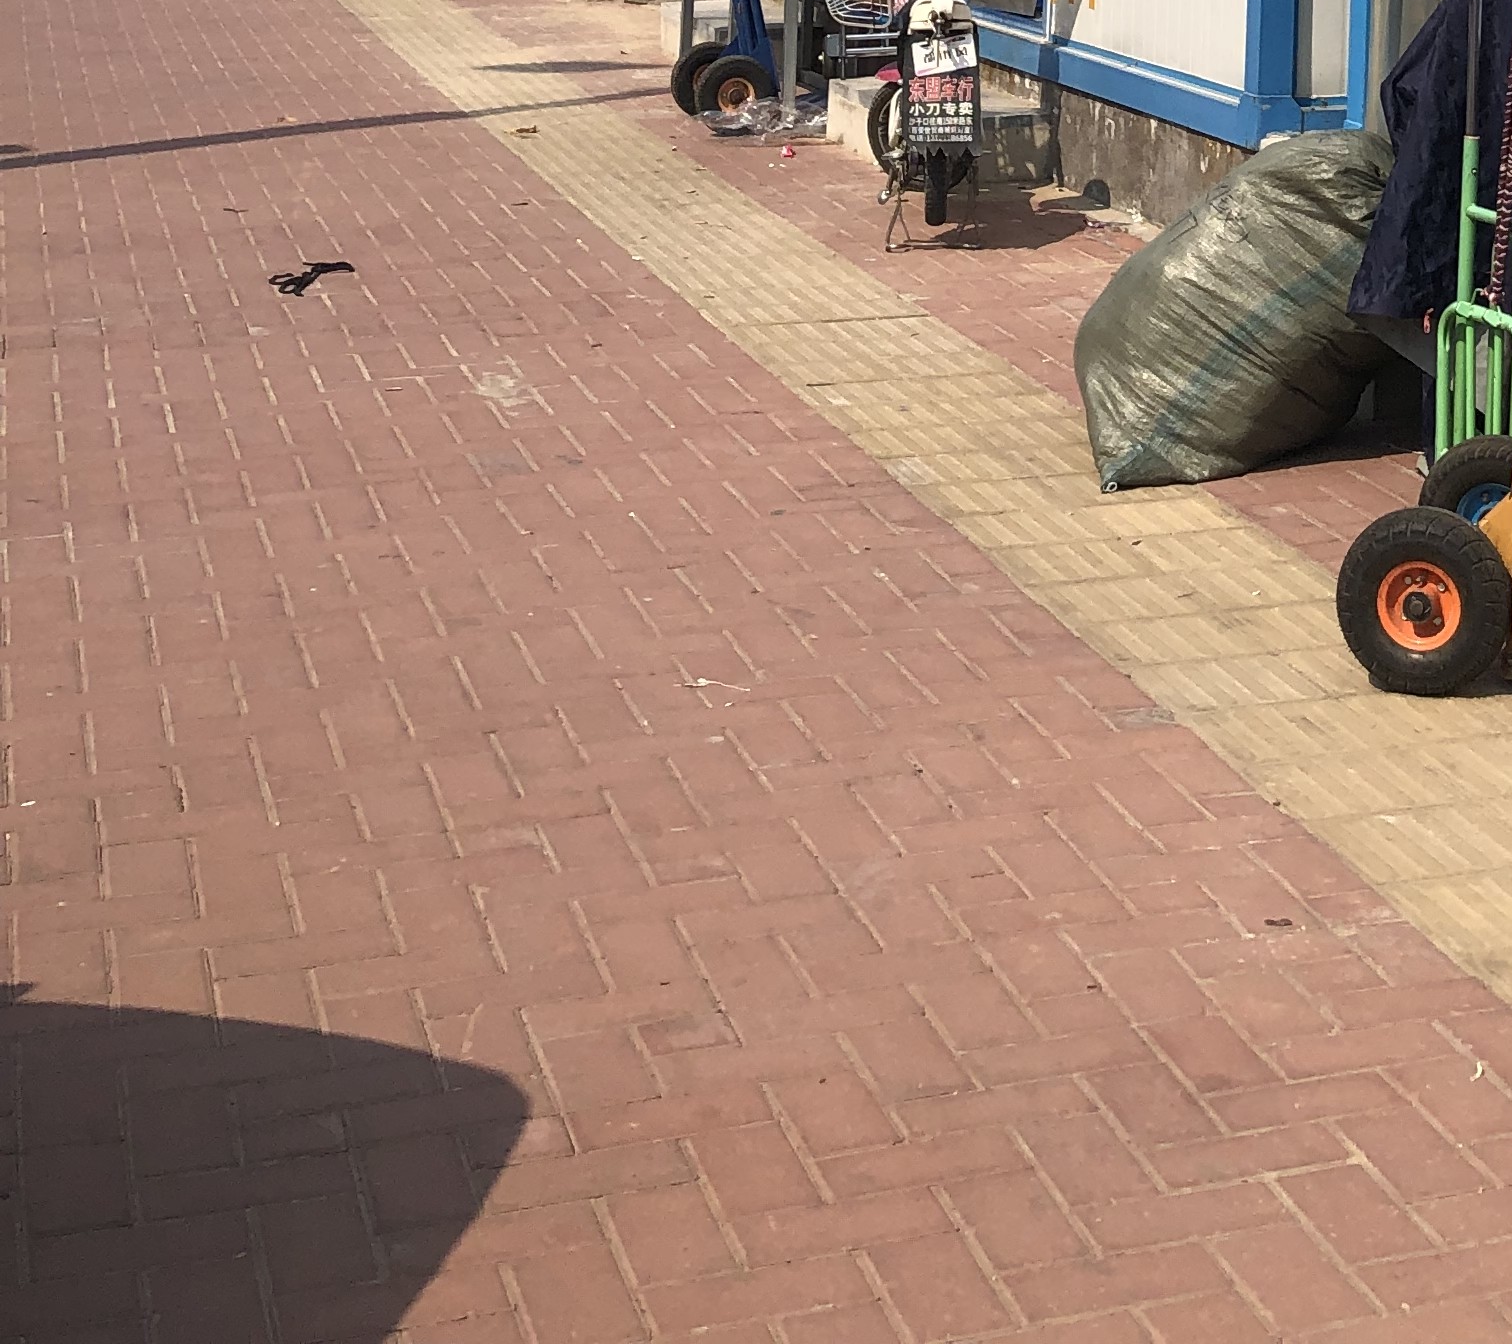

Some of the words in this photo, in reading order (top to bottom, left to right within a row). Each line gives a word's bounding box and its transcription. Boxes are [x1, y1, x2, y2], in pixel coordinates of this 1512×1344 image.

[908, 75, 974, 103] 东盟车行
[909, 102, 974, 116] 小刀专卖
